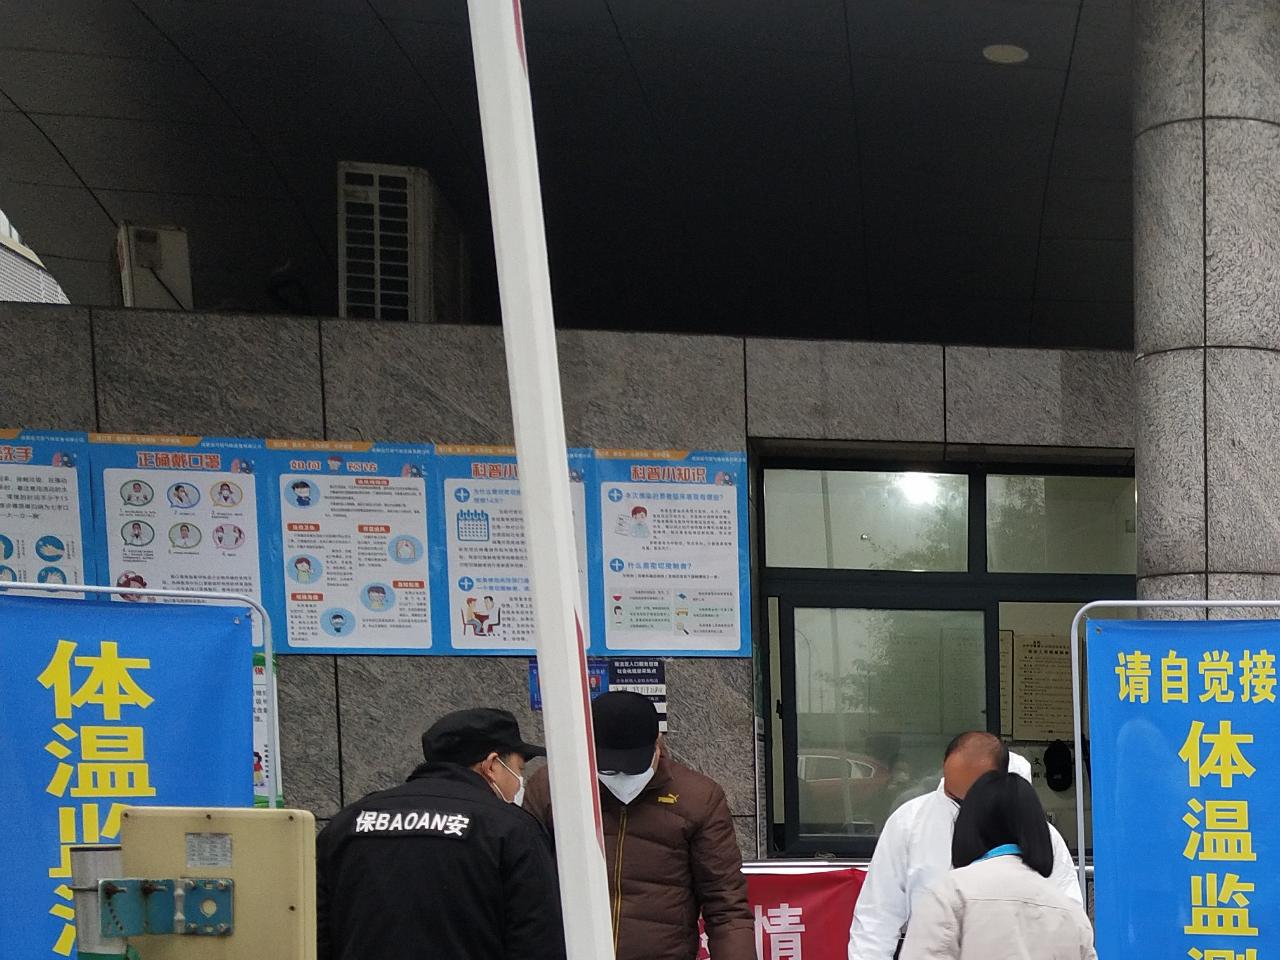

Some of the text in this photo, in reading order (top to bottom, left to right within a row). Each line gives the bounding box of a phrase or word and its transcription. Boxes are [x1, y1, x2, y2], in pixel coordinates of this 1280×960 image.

[137, 451, 221, 469] 正确戴口罩
[471, 463, 519, 479] 科普小
[631, 465, 707, 483] 科普小知识
[356, 810, 470, 836] 保BAOAN安
